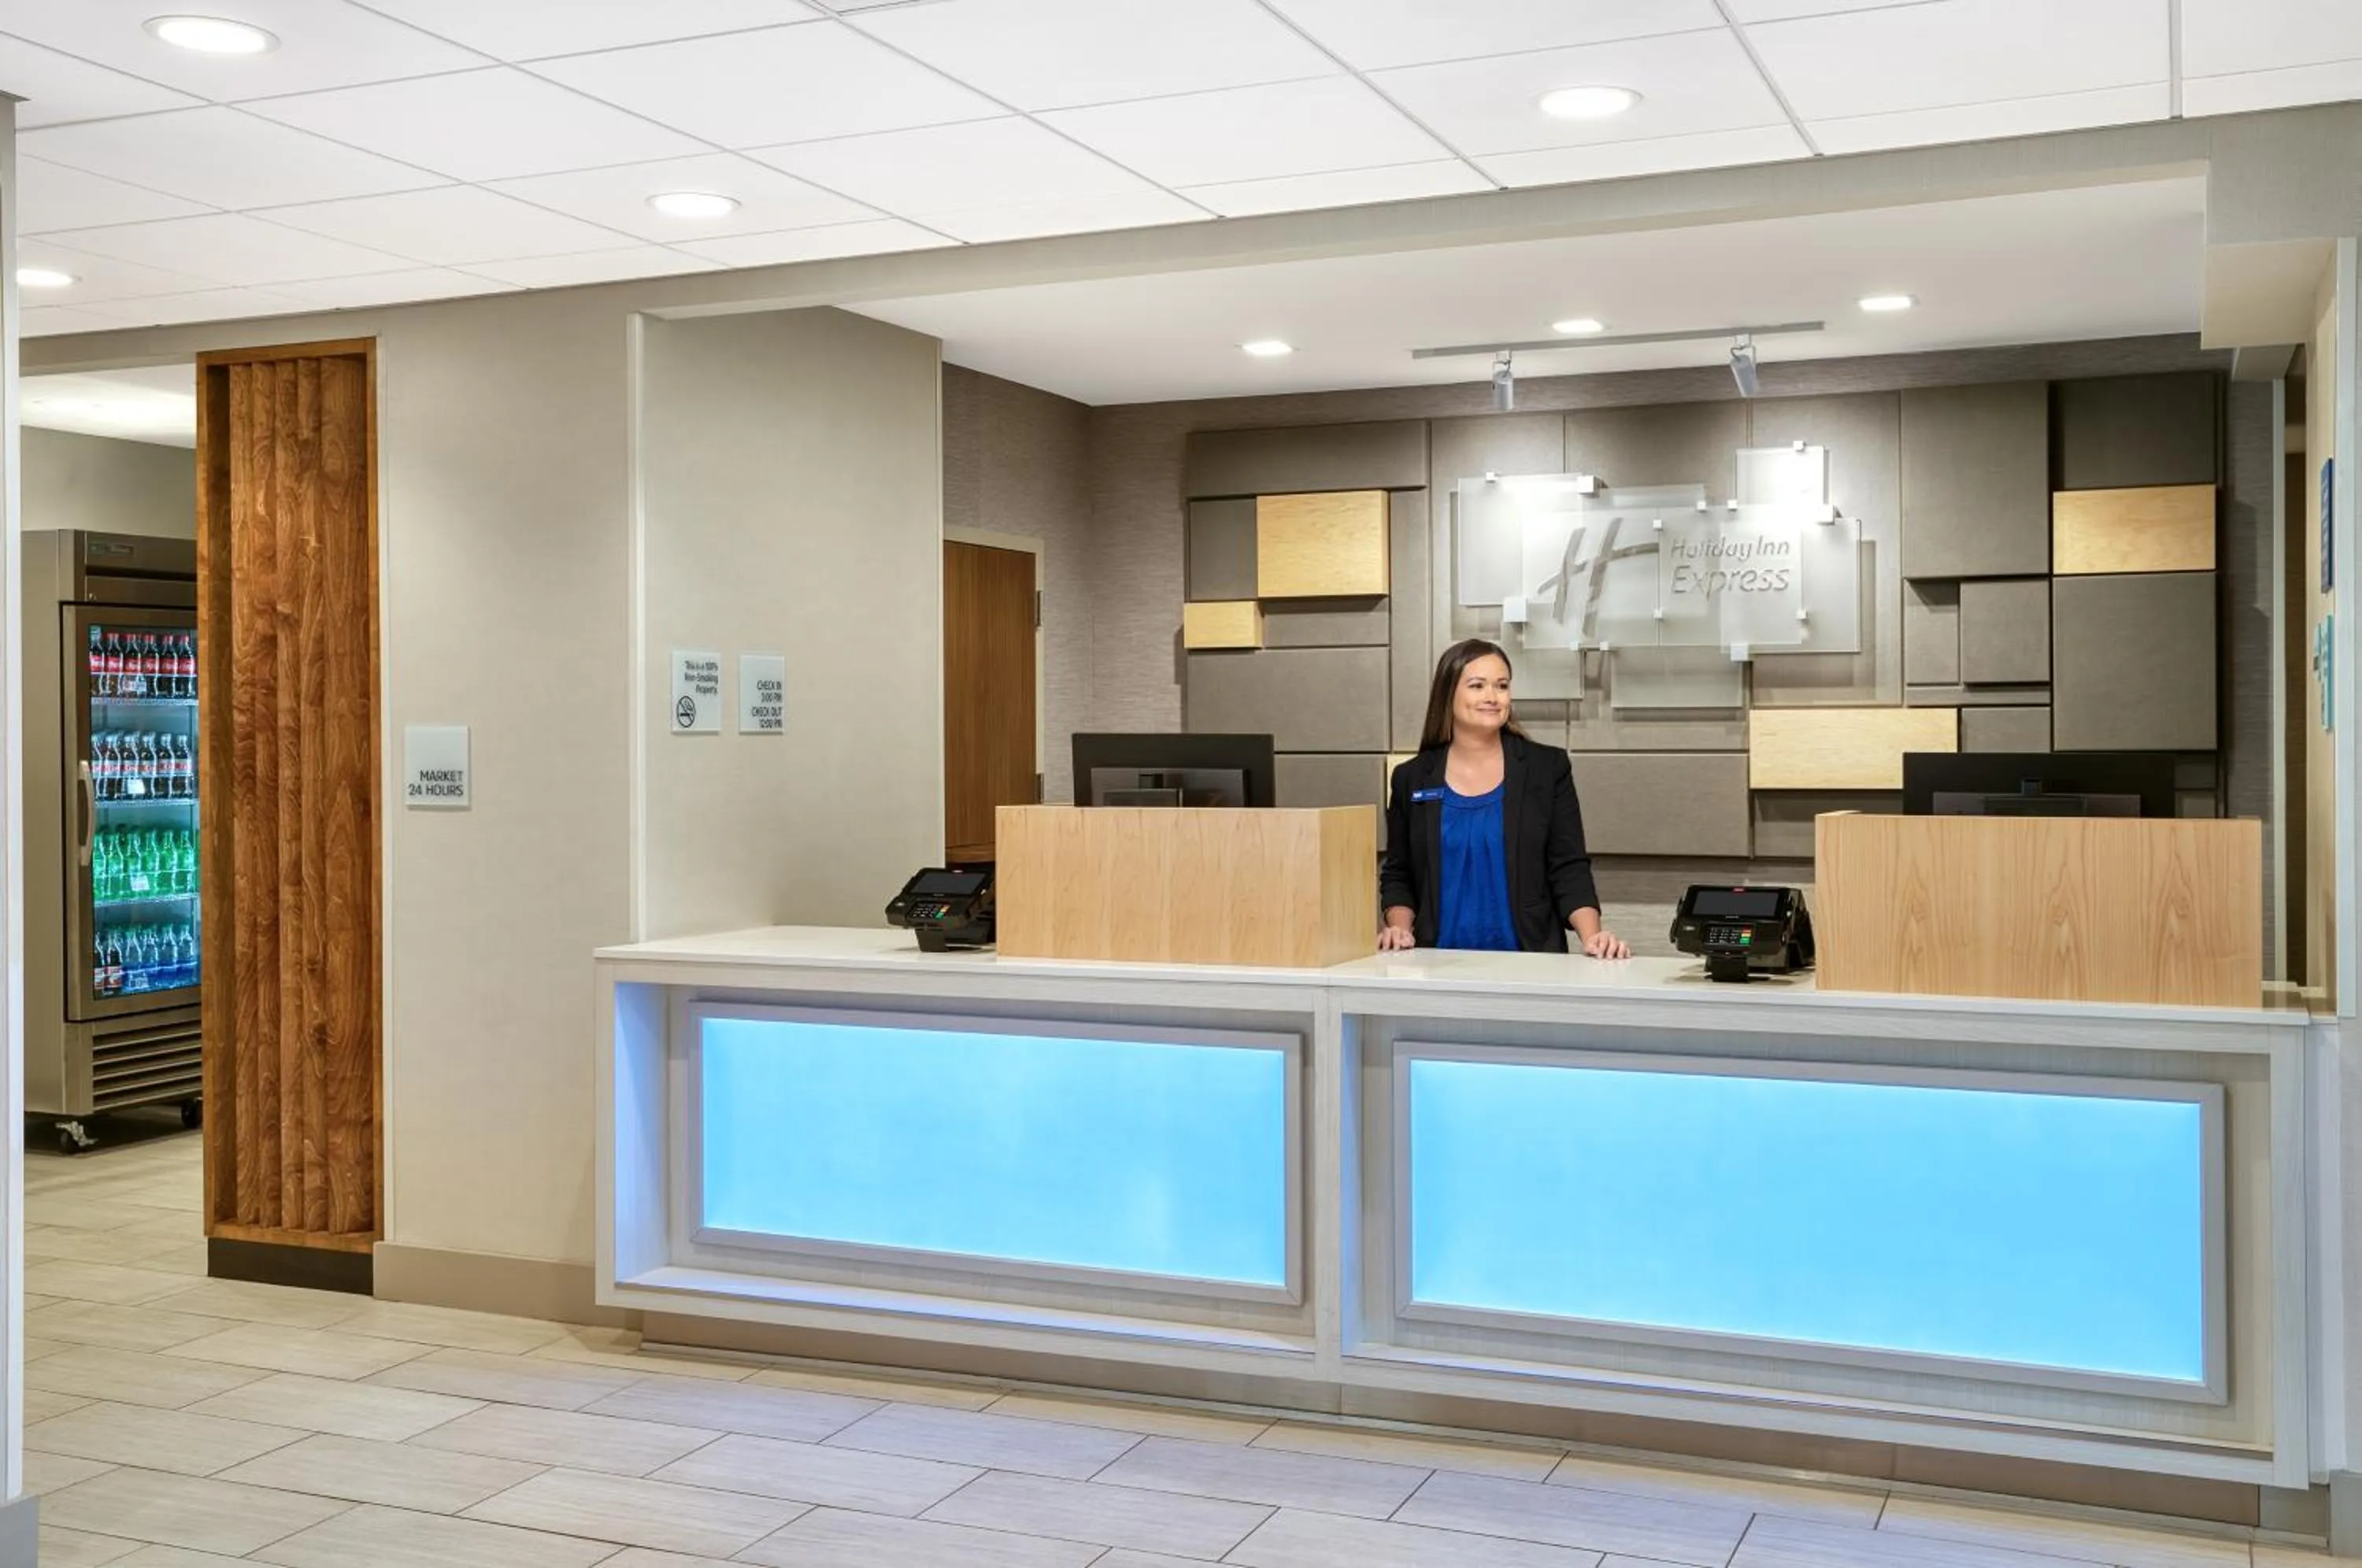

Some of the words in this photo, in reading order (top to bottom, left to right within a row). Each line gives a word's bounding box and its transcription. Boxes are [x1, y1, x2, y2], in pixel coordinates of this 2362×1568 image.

[1671, 535, 1753, 563] Holiday
[1757, 534, 1790, 556] Inn
[1671, 564, 1790, 602] Express
[757, 679, 776, 690] CHECK
[776, 681, 782, 690] IN
[774, 693, 782, 703] PM
[751, 706, 769, 717] CHECK
[771, 706, 782, 717] OUT
[774, 719, 782, 728] PM
[420, 770, 463, 782] MARKET
[408, 783, 423, 796] 24
[425, 784, 464, 797] HOURS
